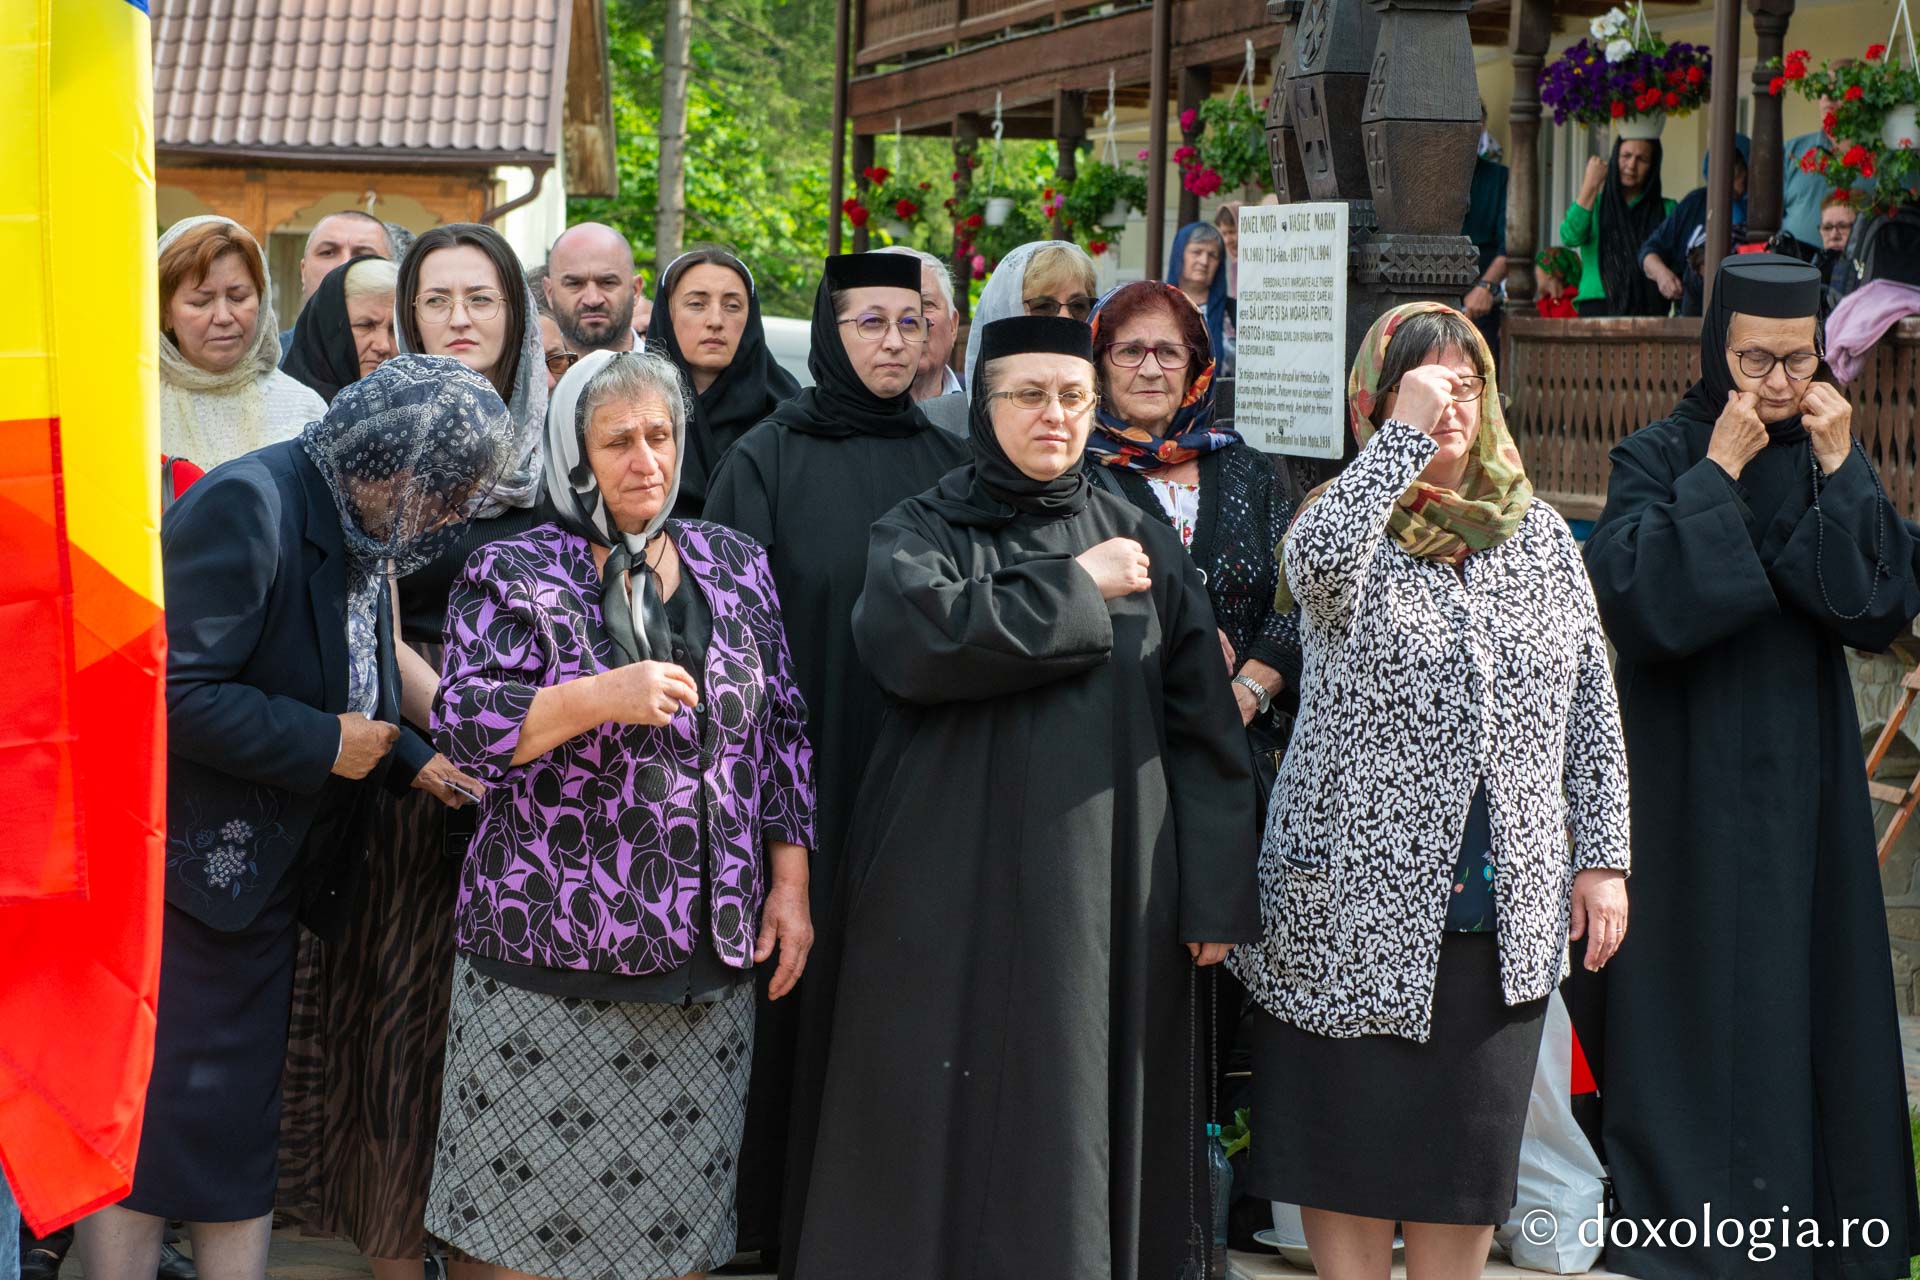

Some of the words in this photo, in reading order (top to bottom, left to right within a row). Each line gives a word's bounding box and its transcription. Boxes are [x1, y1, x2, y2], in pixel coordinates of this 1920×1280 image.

[1241, 215, 1258, 234] IONEL
[1289, 213, 1311, 232] VASILE
[1314, 212, 1335, 231] MARIN
[1257, 306, 1274, 320] LUPTE
[1311, 306, 1332, 320] PENTRU
[1239, 326, 1260, 340] HRISTOS
